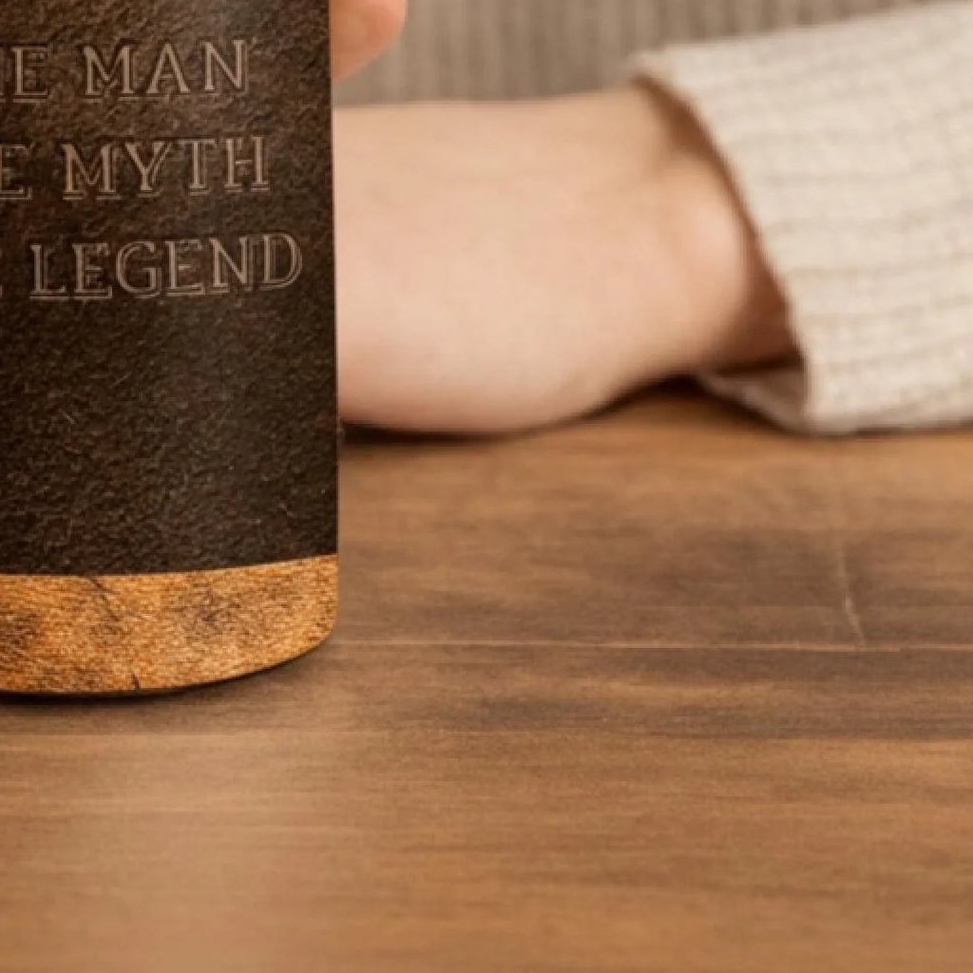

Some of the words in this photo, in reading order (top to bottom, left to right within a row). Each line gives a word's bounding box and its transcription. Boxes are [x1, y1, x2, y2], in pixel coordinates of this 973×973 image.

[82, 38, 251, 103] MAN
[62, 135, 270, 200] MYTH
[29, 232, 303, 299] LEGEND
